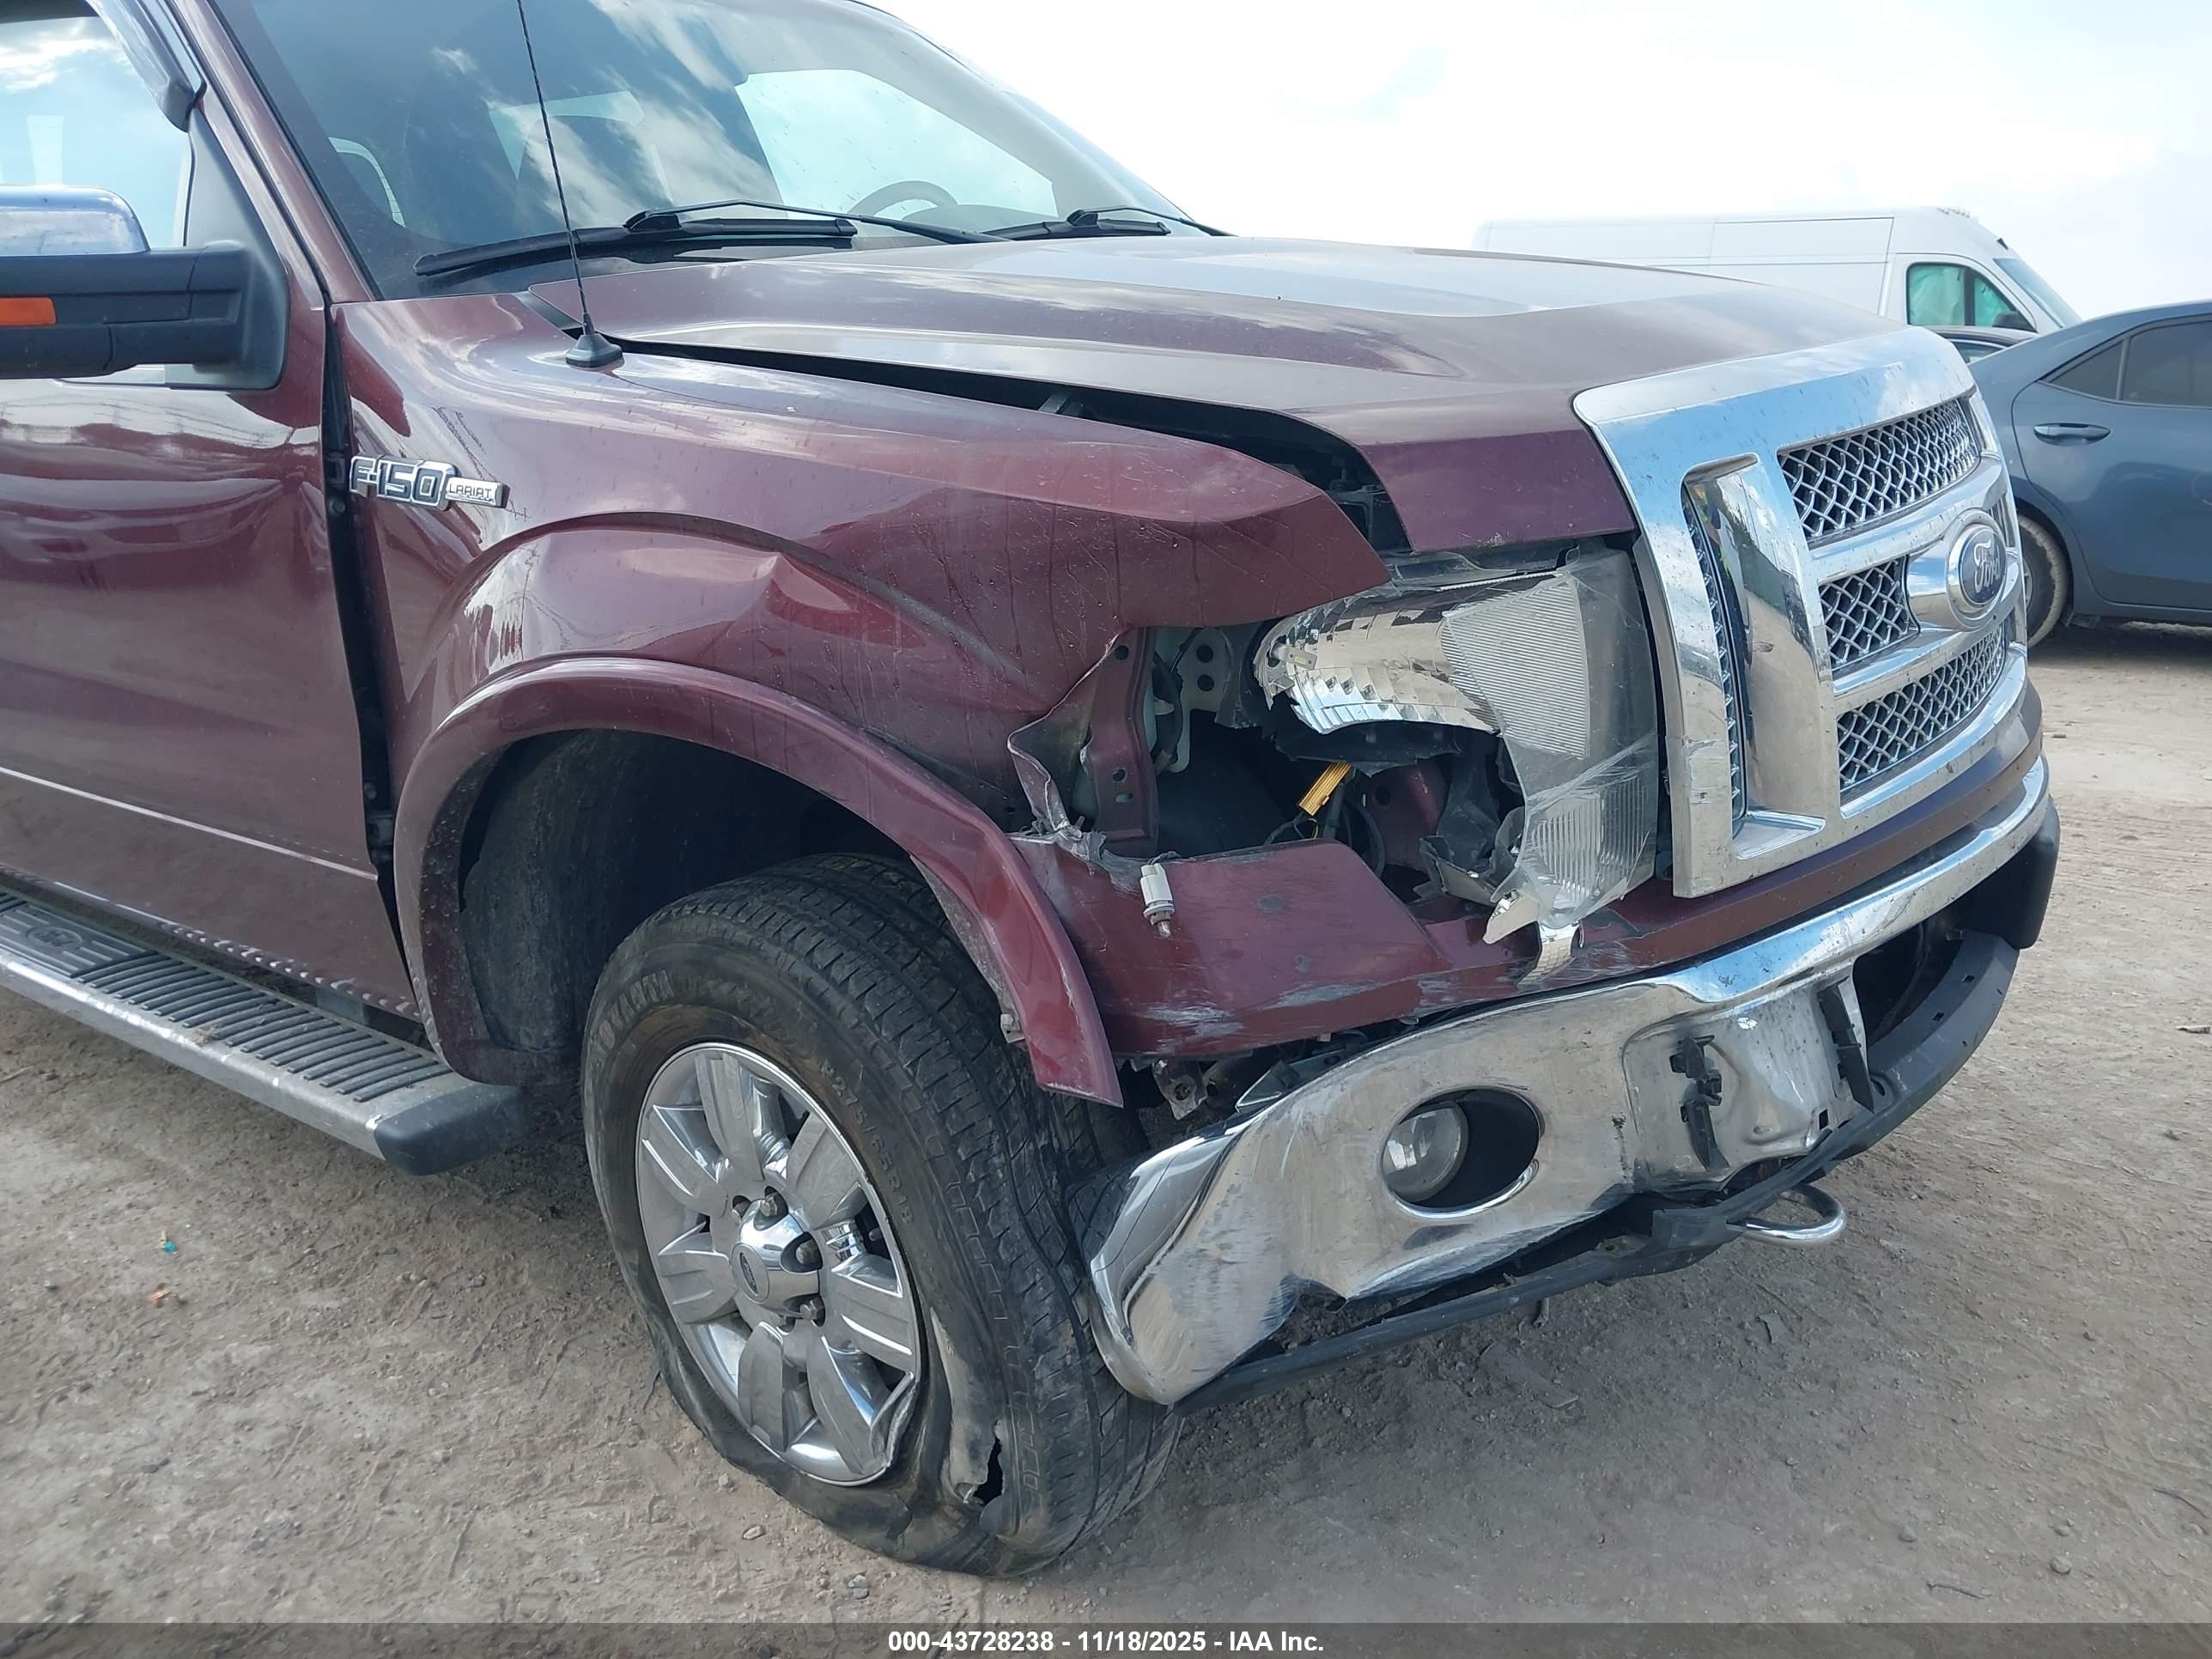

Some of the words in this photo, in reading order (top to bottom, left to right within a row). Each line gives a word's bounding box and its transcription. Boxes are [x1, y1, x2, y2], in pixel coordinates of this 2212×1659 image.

[349, 455, 453, 509] F-150
[448, 483, 493, 500] LARIAT
[1973, 538, 2001, 594] Ford
